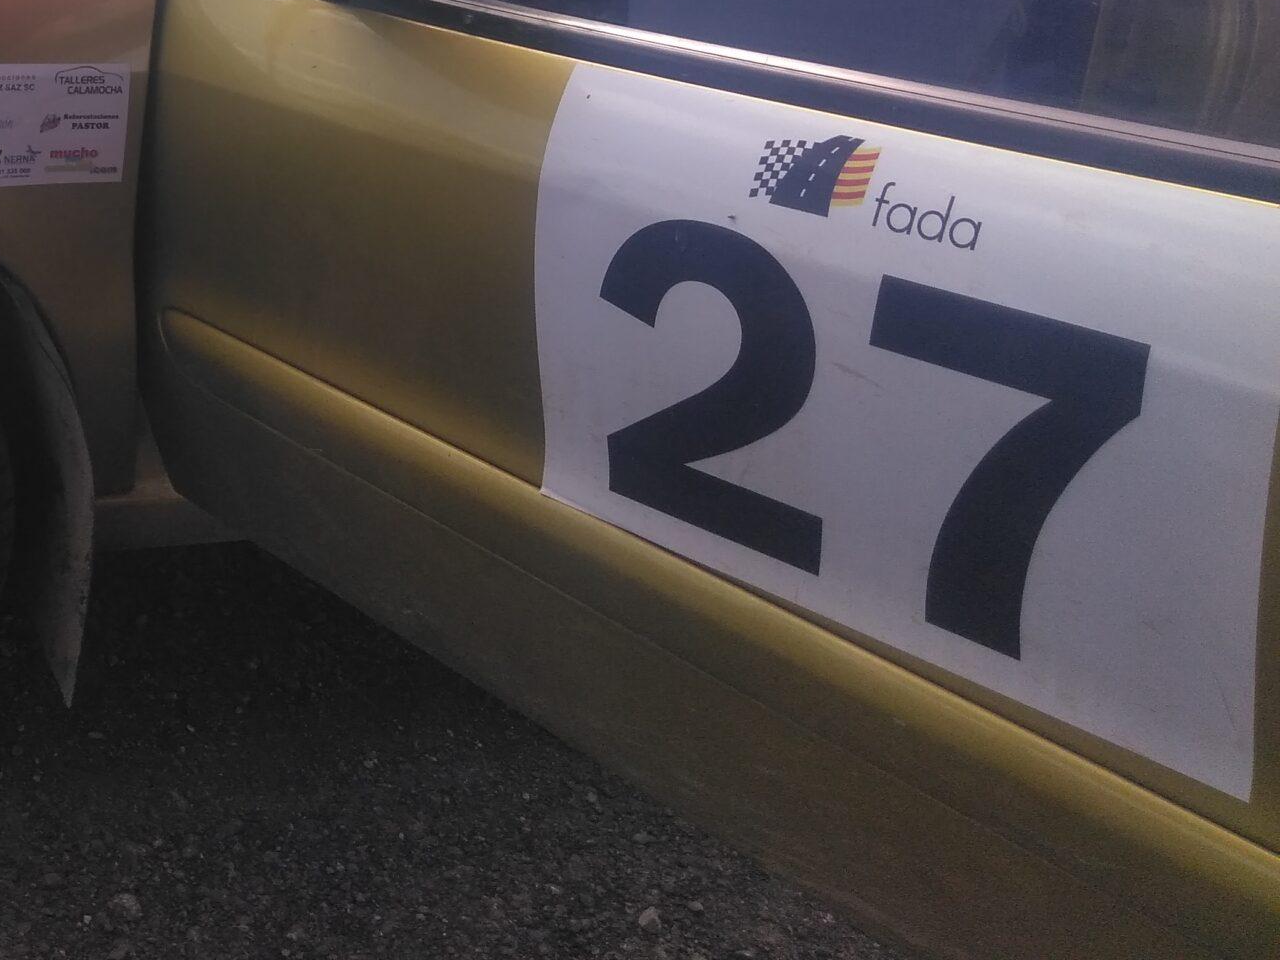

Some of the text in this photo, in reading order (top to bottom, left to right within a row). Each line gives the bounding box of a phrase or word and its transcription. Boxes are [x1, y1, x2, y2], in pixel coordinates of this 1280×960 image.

[59, 75, 106, 85] TALLERES
[67, 85, 123, 95] CALAMOCHA
[71, 122, 110, 130] PASTOR
[49, 147, 98, 159] mucho
[870, 181, 983, 251] fada
[599, 218, 1152, 661] 27
